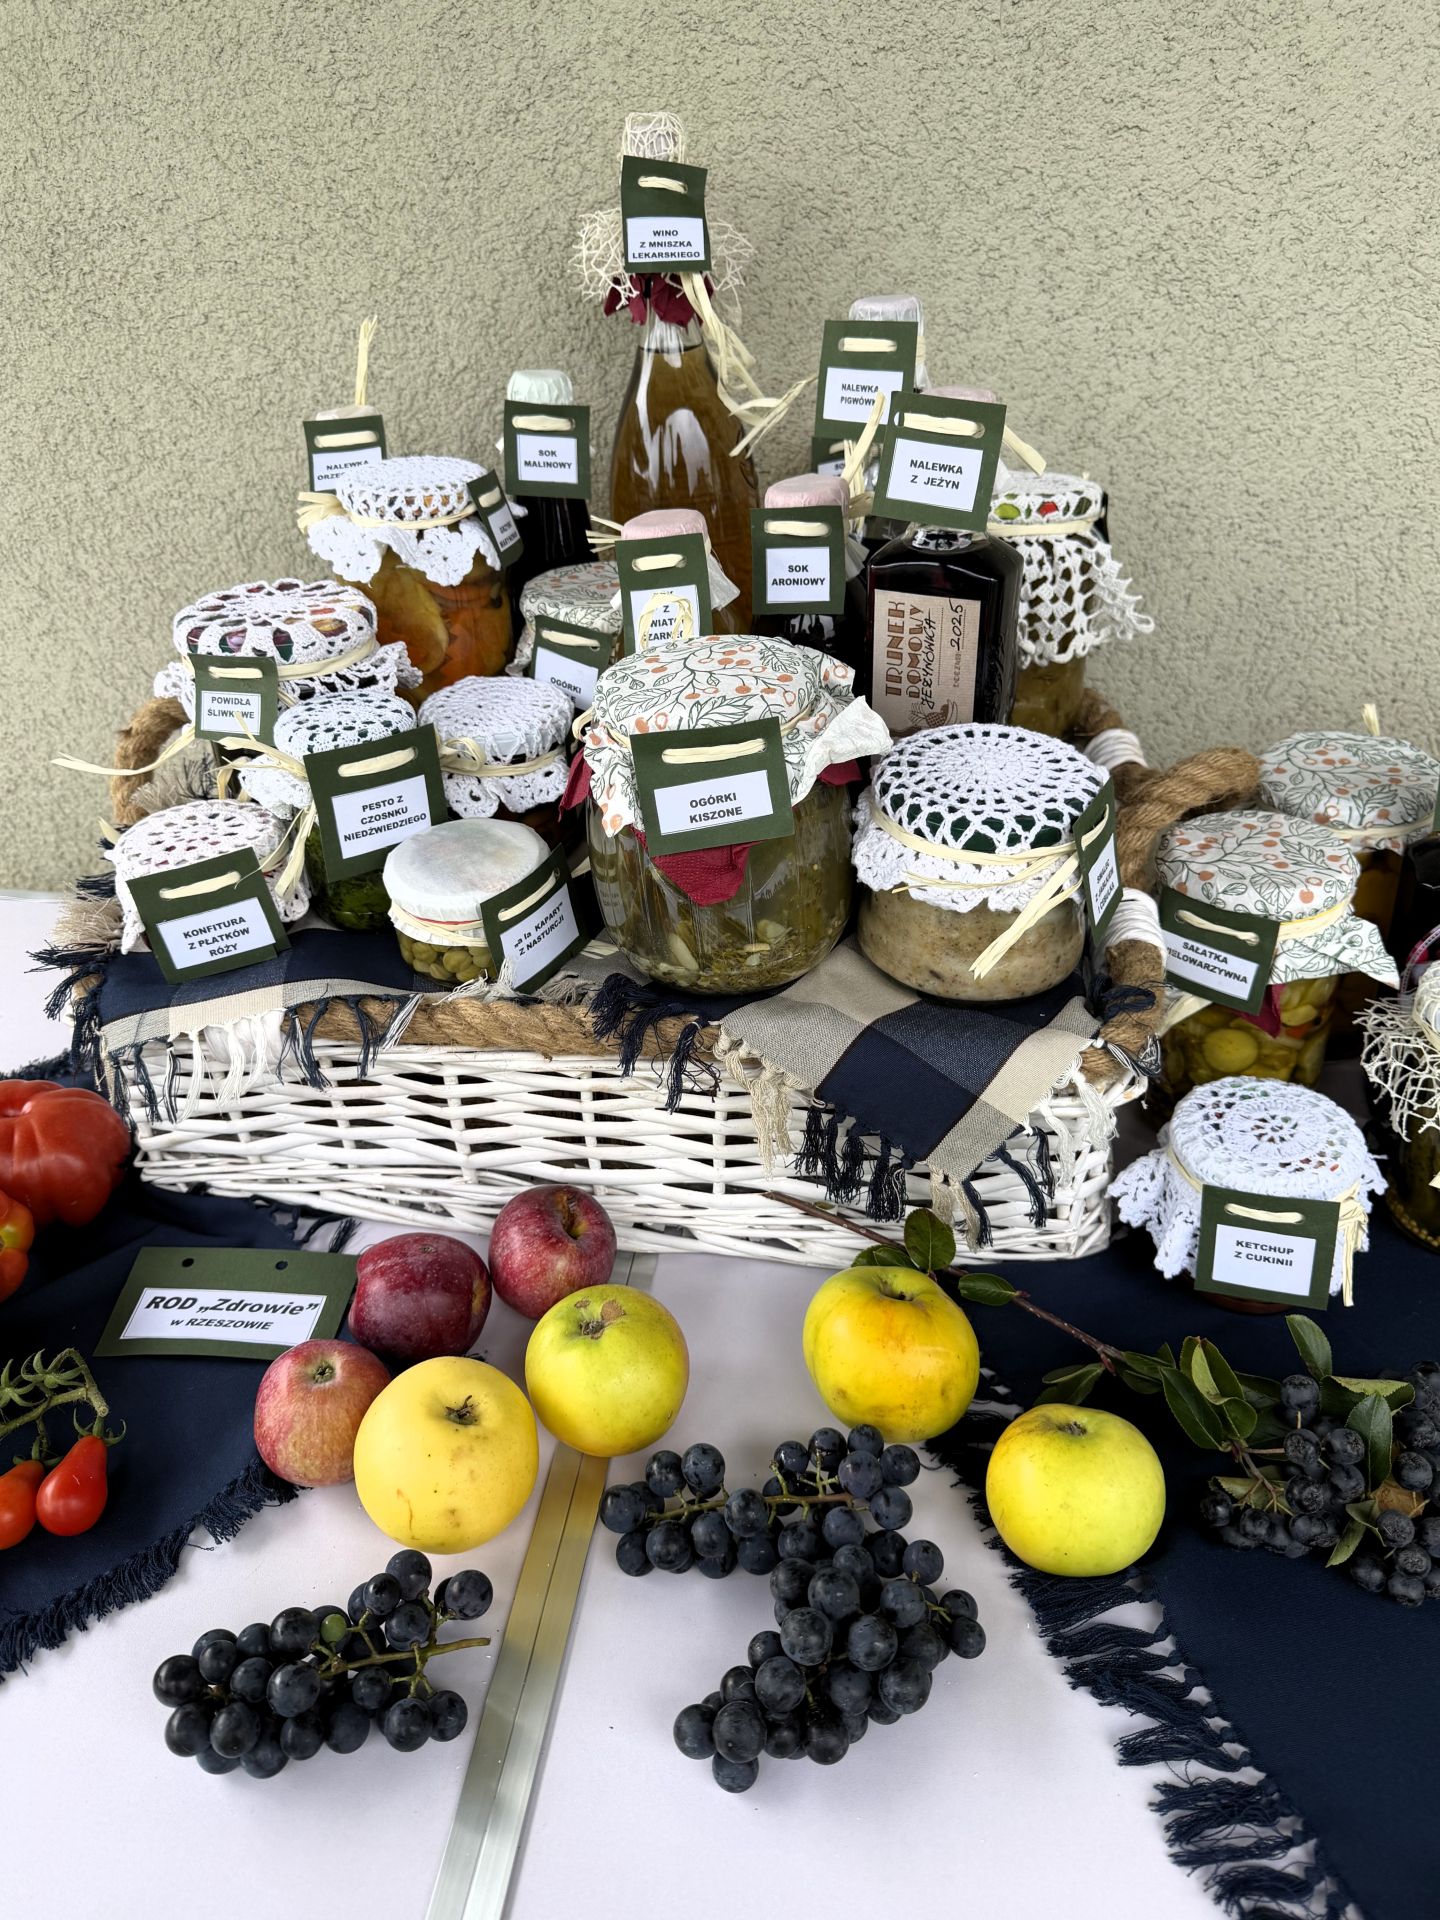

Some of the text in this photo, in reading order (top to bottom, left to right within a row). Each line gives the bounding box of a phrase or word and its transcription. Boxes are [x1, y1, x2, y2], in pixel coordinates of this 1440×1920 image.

[841, 383, 879, 393] NALEWKA
[326, 460, 369, 470] NALEWKA
[524, 460, 572, 469] MALINOWY
[910, 459, 963, 475] NALEWKA
[317, 472, 345, 480] ORZE
[910, 475, 960, 490] Z JEŻYN
[788, 565, 808, 573] SOK
[771, 578, 825, 586] ARONIOWY
[663, 605, 670, 613] Z
[949, 598, 964, 651] 2025
[885, 601, 905, 696] TRUNEK
[906, 604, 924, 698] DOMOWY
[550, 677, 582, 694] OGÓRKI
[211, 696, 251, 706] POWIDŁA
[207, 707, 255, 719] ŚLIWKWE
[362, 795, 404, 813] PESTO Z
[689, 792, 737, 808] OGÓRKI
[360, 806, 408, 825] CZOSNKU
[689, 806, 743, 824] KISZONE
[183, 916, 247, 939] KONFITURA
[519, 914, 565, 956] Z NASTURCJI
[188, 927, 250, 950] Z PŁATKÓW
[523, 932, 532, 940] la
[209, 943, 238, 957] RÓŻY
[1183, 941, 1228, 965] SAŁATKA
[1167, 947, 1248, 984] IELOWARZYWNA
[1235, 1240, 1295, 1255] KETCHUP
[1233, 1251, 1293, 1267] Z CUKINII
[145, 1296, 320, 1316] ROD „Zdrowie”
[185, 1318, 274, 1331] RZESZOWIE
